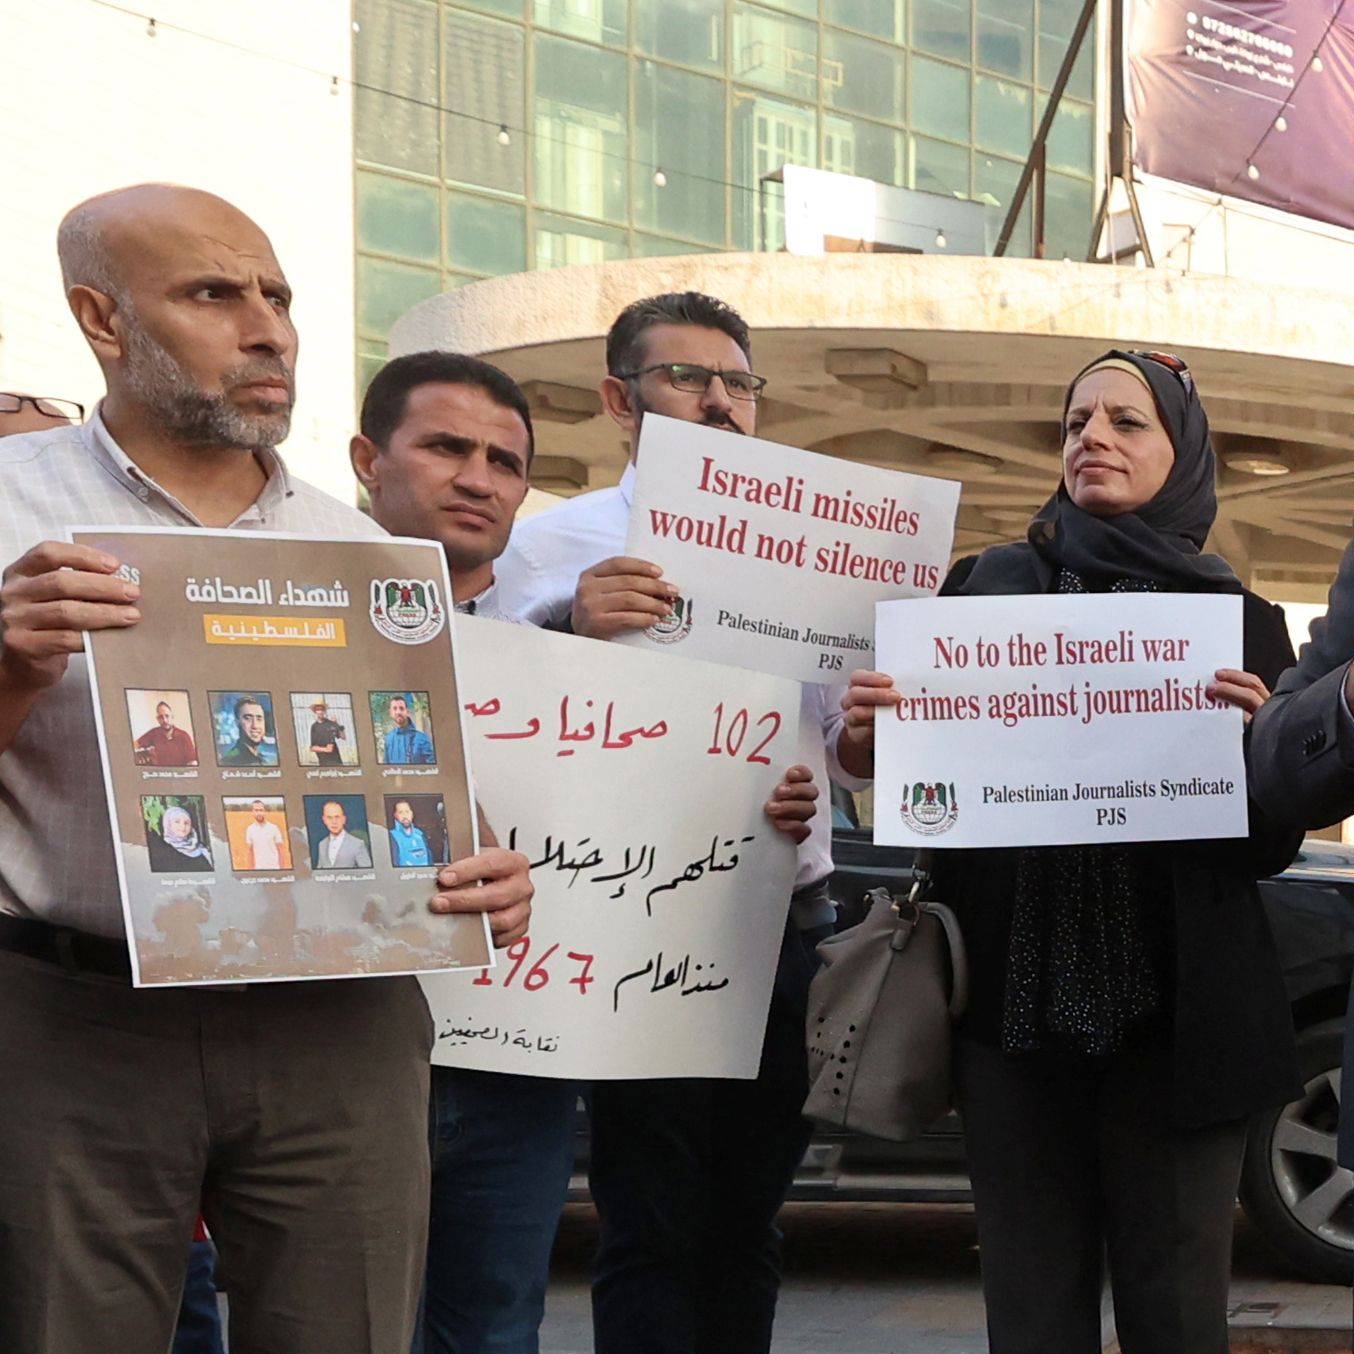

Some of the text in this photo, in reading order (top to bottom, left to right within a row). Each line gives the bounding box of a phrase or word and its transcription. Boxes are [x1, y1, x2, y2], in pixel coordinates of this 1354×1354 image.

[697, 456, 920, 537] Israeli missiles
[649, 508, 940, 590] would not silence us
[184, 575, 350, 608] شهداء الصحافة
[211, 618, 336, 640] الفلسطينية
[716, 609, 871, 652] Palestinian Journalists
[933, 630, 1191, 669] No to the Israeli war
[817, 652, 844, 672] PJS
[557, 695, 668, 757] صحافيا
[895, 687, 981, 722] crimes
[988, 683, 1079, 728] against
[707, 702, 782, 765] 102
[982, 776, 1235, 805] Palestinian Journalists Syndicate
[1095, 807, 1127, 827] PJS
[646, 835, 755, 916] قتلهم
[472, 936, 729, 1012] منذ العام 967
[513, 1028, 561, 1053] نقابة
